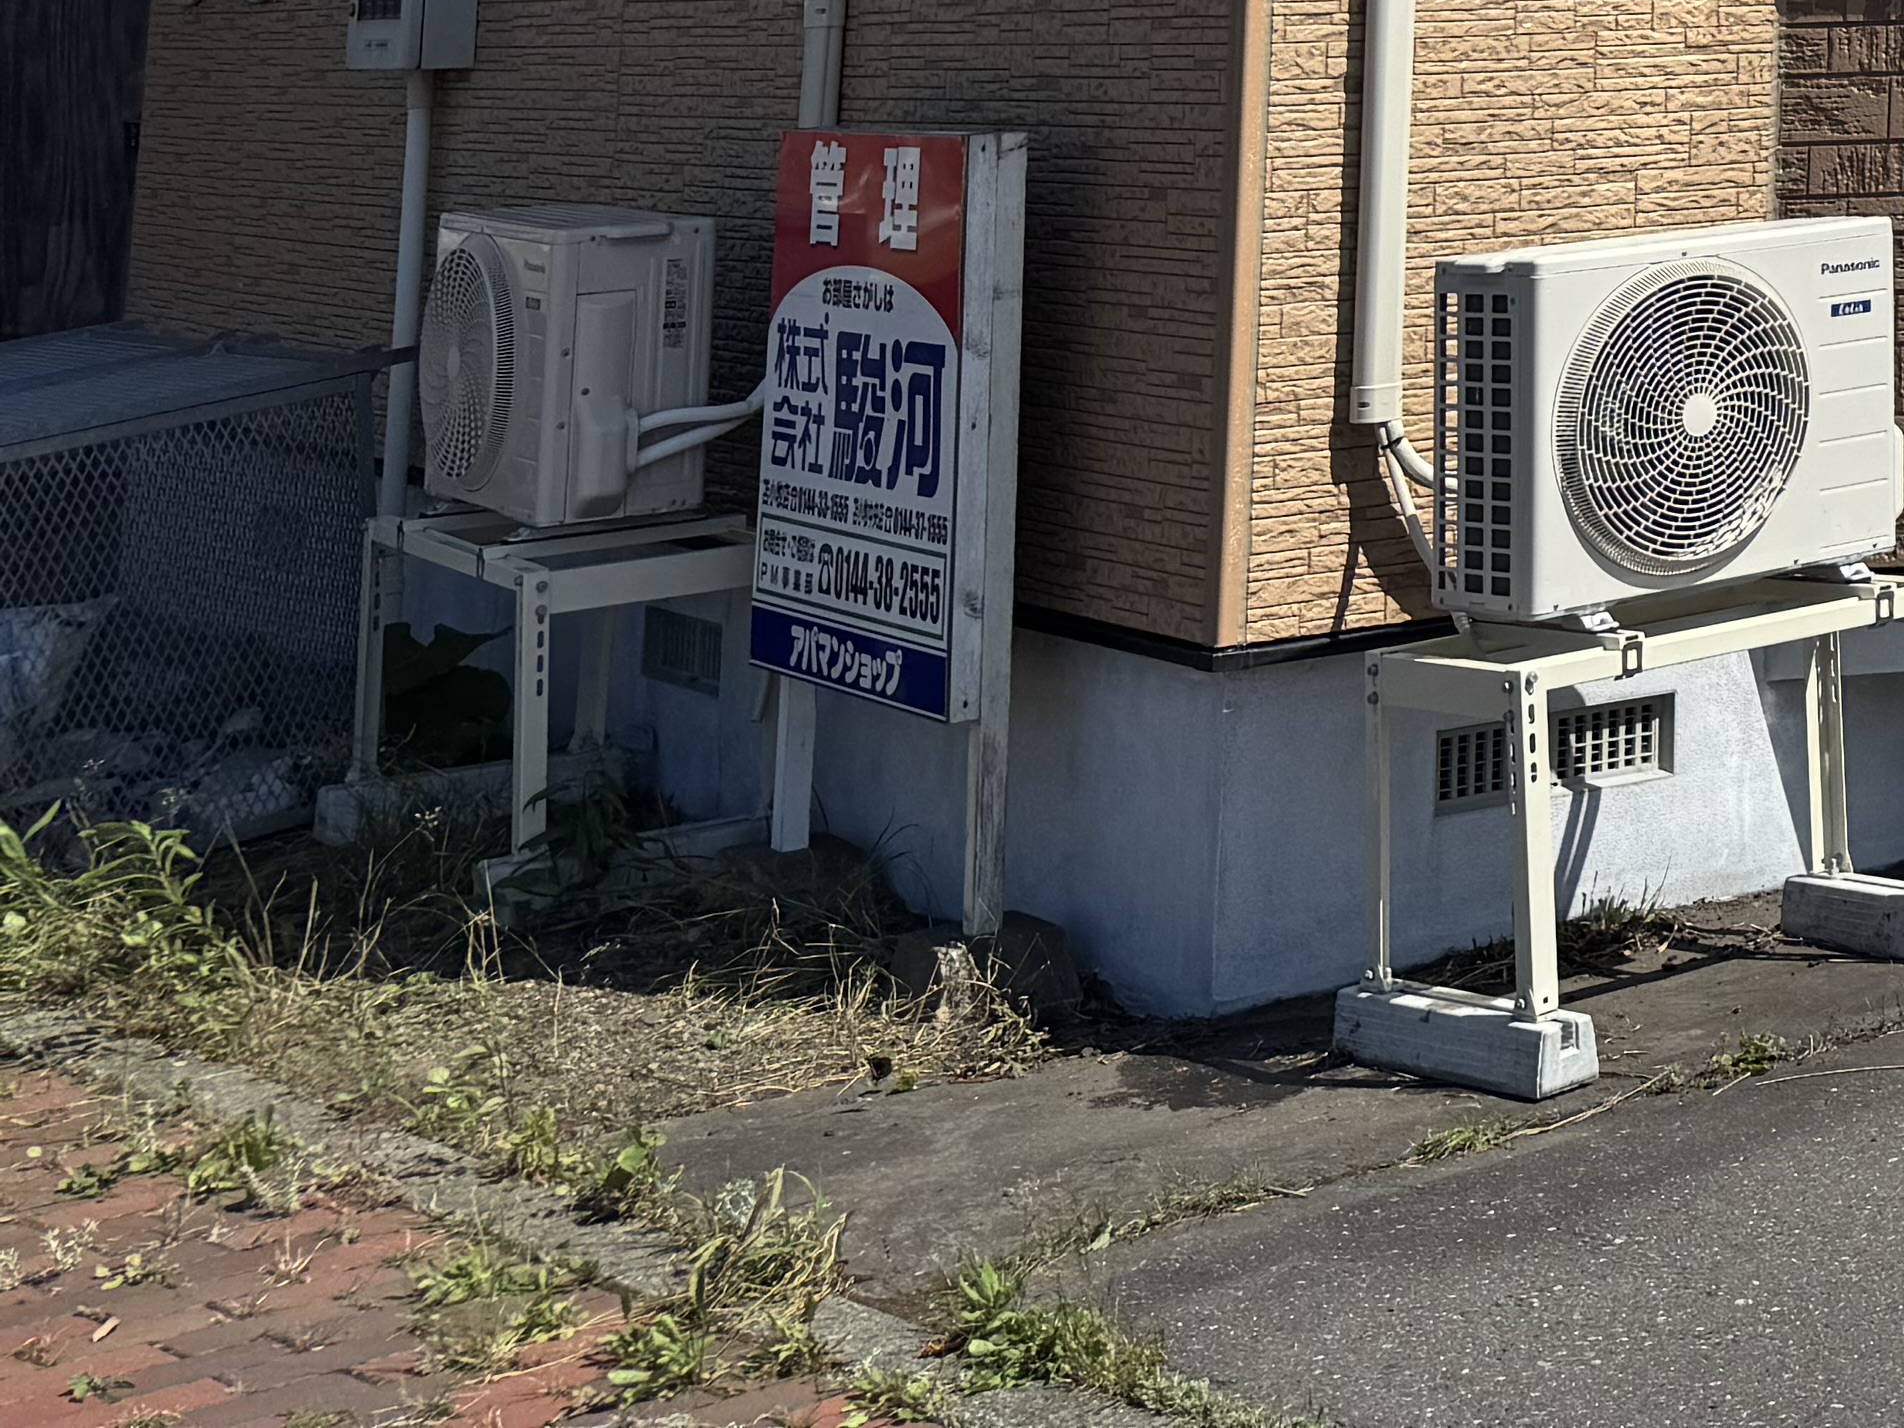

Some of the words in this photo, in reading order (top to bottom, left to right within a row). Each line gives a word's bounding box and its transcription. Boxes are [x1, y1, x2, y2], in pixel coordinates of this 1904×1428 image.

[810, 140, 921, 251] 管理
[822, 277, 894, 312] お部屋さがしは
[1820, 257, 1880, 275] Panasonic
[828, 331, 946, 499] 駿河
[834, 546, 941, 624] 0144-38-2555
[789, 624, 903, 696] アパマンショップ
